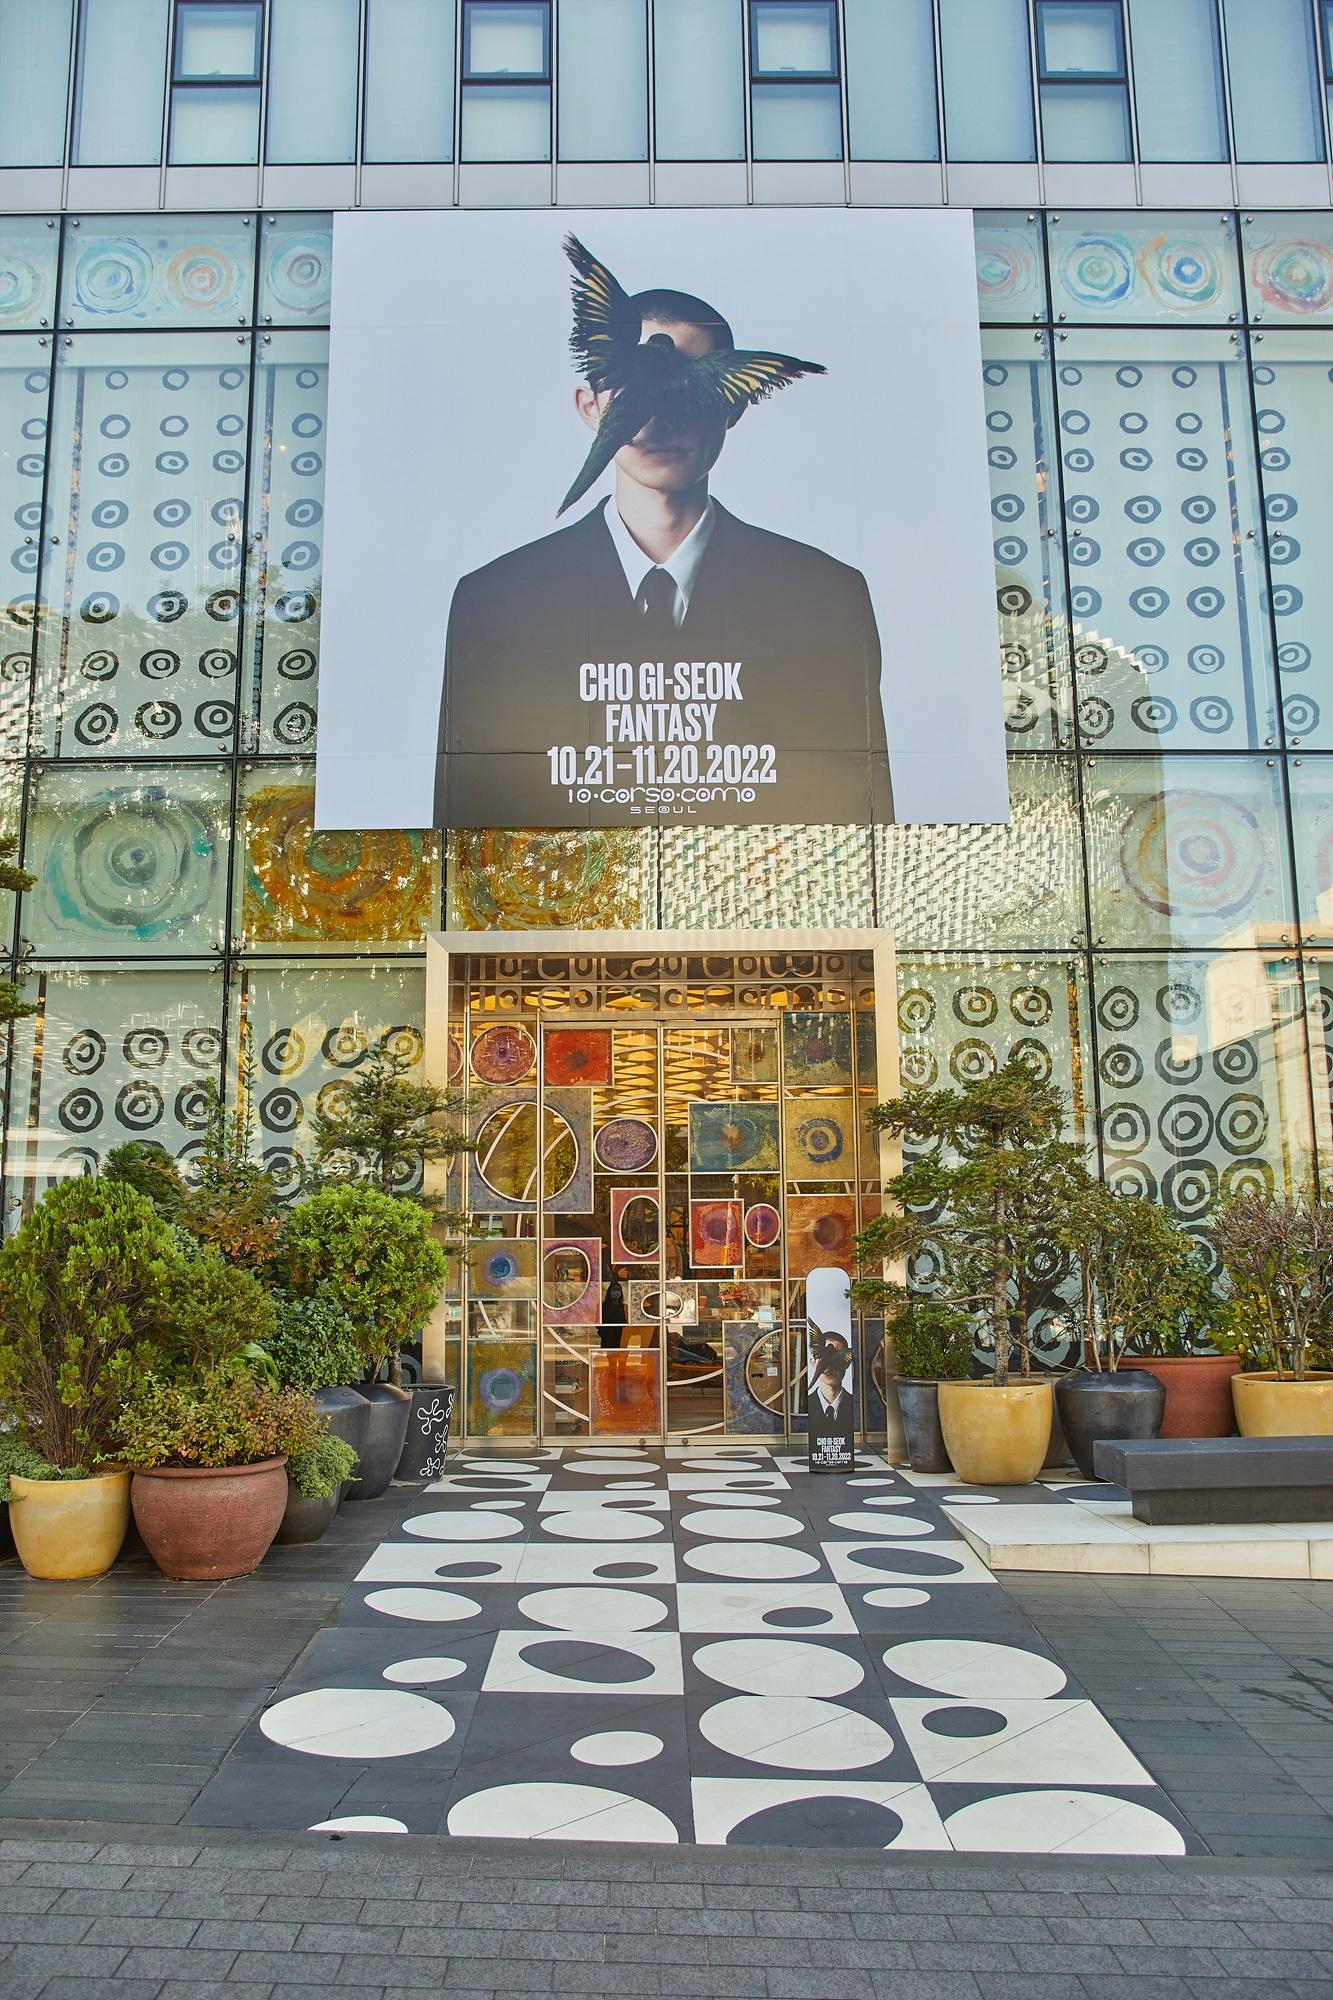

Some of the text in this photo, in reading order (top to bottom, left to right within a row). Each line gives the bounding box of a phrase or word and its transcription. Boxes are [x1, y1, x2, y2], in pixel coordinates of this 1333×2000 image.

[579, 661, 744, 702] CHO GI-SEOK
[605, 703, 718, 743] FANTASY
[630, 806, 697, 814] SEOUL
[703, 984, 848, 1011] como
[816, 1437, 827, 1446] CHO
[821, 1445, 841, 1453] FANTASY
